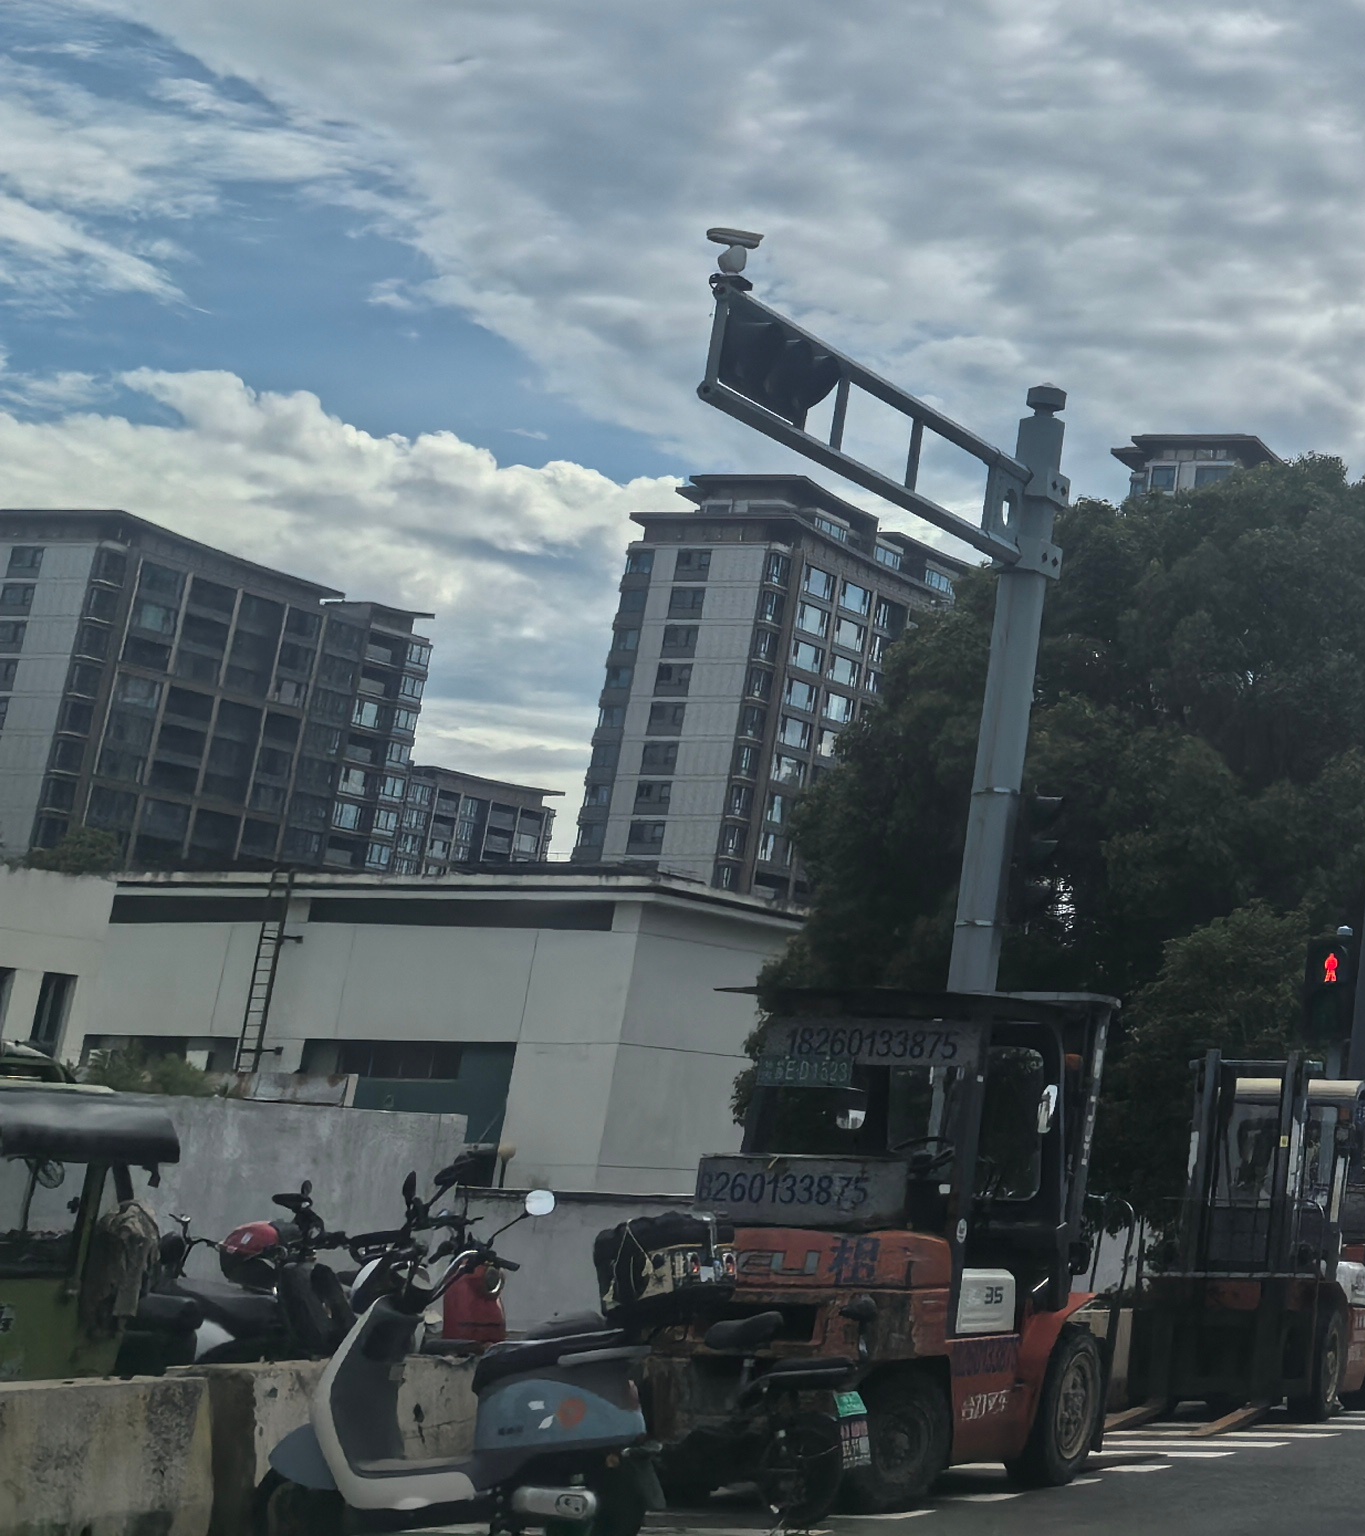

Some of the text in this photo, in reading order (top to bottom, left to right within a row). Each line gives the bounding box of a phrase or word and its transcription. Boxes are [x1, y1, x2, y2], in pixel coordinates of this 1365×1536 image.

[787, 1027, 958, 1061] 18260133875
[827, 1235, 881, 1287] 租
[984, 1286, 1004, 1304] 35
